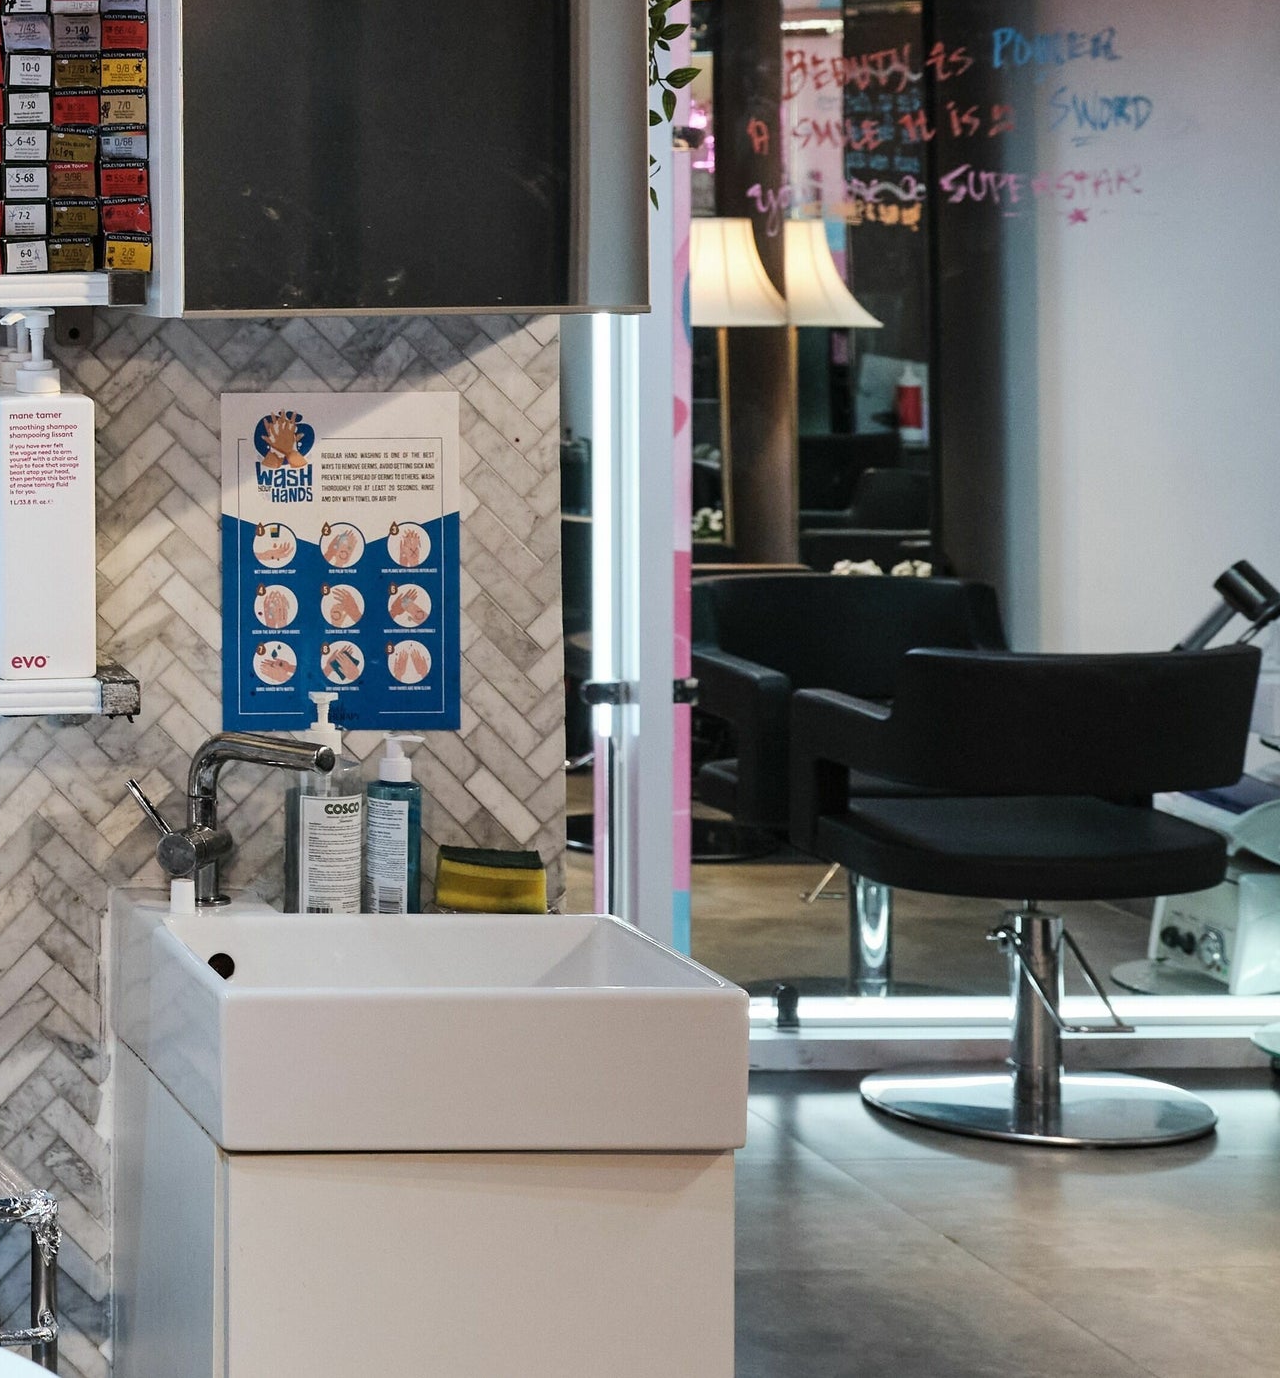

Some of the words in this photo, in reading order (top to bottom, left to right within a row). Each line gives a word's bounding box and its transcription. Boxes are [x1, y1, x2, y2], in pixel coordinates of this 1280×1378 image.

[65, 25, 90, 35] 9-140
[21, 63, 40, 73] 10-0
[20, 100, 36, 110] 7-50
[117, 100, 131, 110] 7/0
[17, 136, 36, 146] 6-45
[15, 173, 35, 183] 5-68
[18, 211, 31, 220] 7-2
[20, 249, 32, 258] 6-0
[9, 432, 50, 440] shampooing
[10, 654, 47, 671] evo
[324, 802, 360, 815] COSCO
